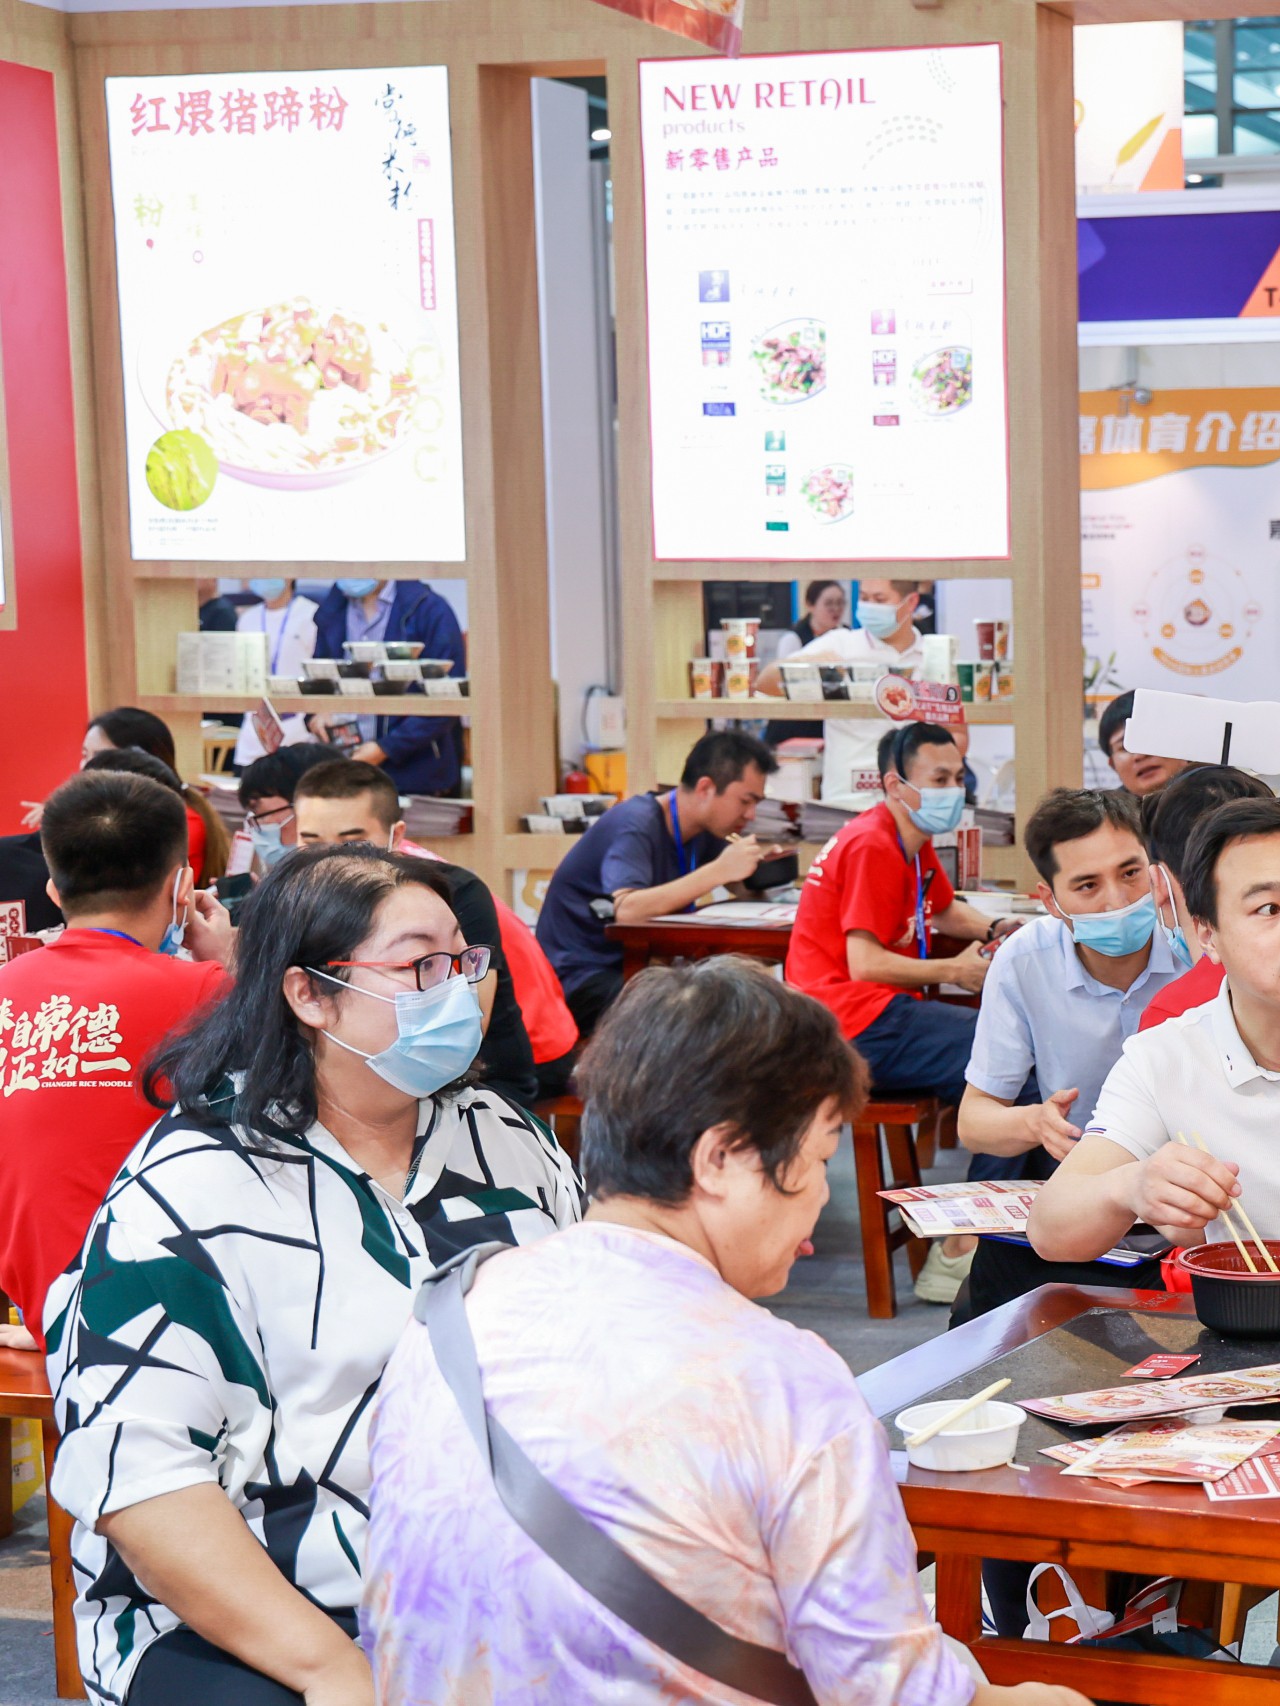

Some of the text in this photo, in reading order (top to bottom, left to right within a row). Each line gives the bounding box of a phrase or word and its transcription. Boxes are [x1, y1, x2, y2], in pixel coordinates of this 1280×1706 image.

[129, 86, 349, 136] 红煨猪蹄粉
[663, 78, 877, 112] NEW RETAIL
[662, 118, 747, 139] products
[665, 147, 779, 171] 新零售产品
[0, 1047, 131, 1098] 正如一
